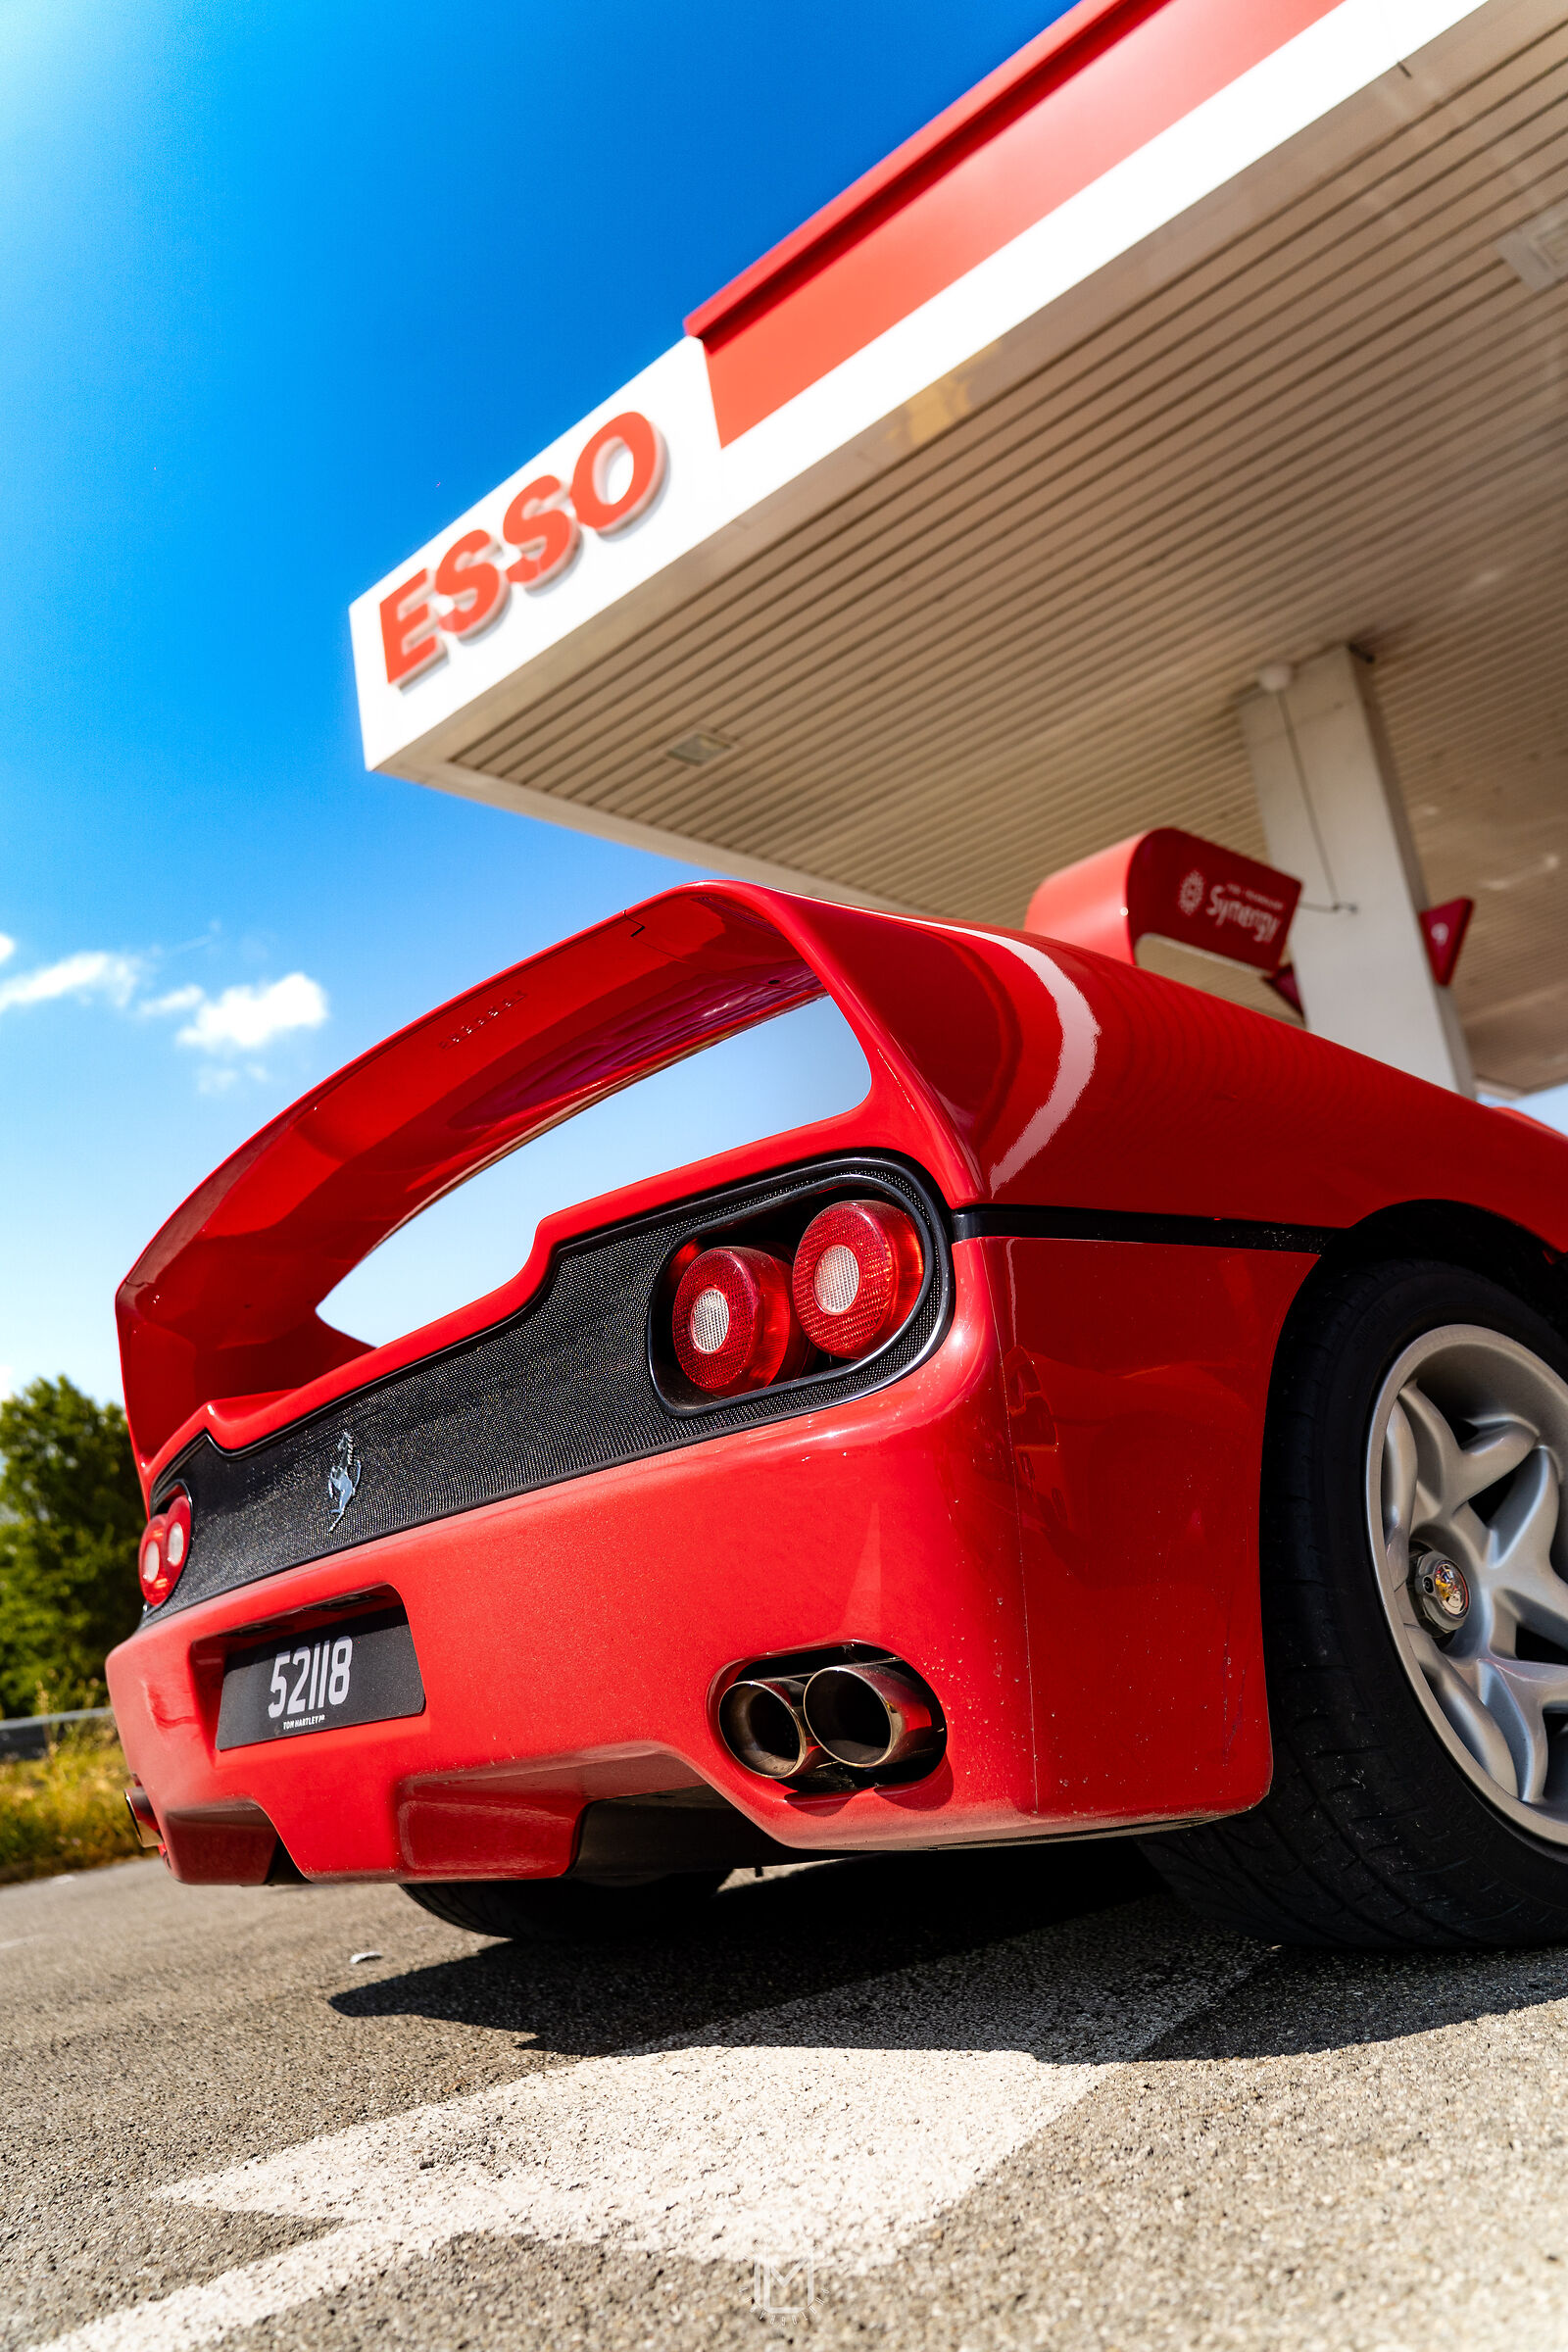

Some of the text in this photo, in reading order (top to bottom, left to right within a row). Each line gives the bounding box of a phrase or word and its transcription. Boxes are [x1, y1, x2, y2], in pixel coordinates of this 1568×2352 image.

[379, 412, 663, 688] ESSO
[1205, 884, 1282, 943] Synergy
[268, 1636, 353, 1718] 52118
[294, 1715, 319, 1728] HARTLEY
